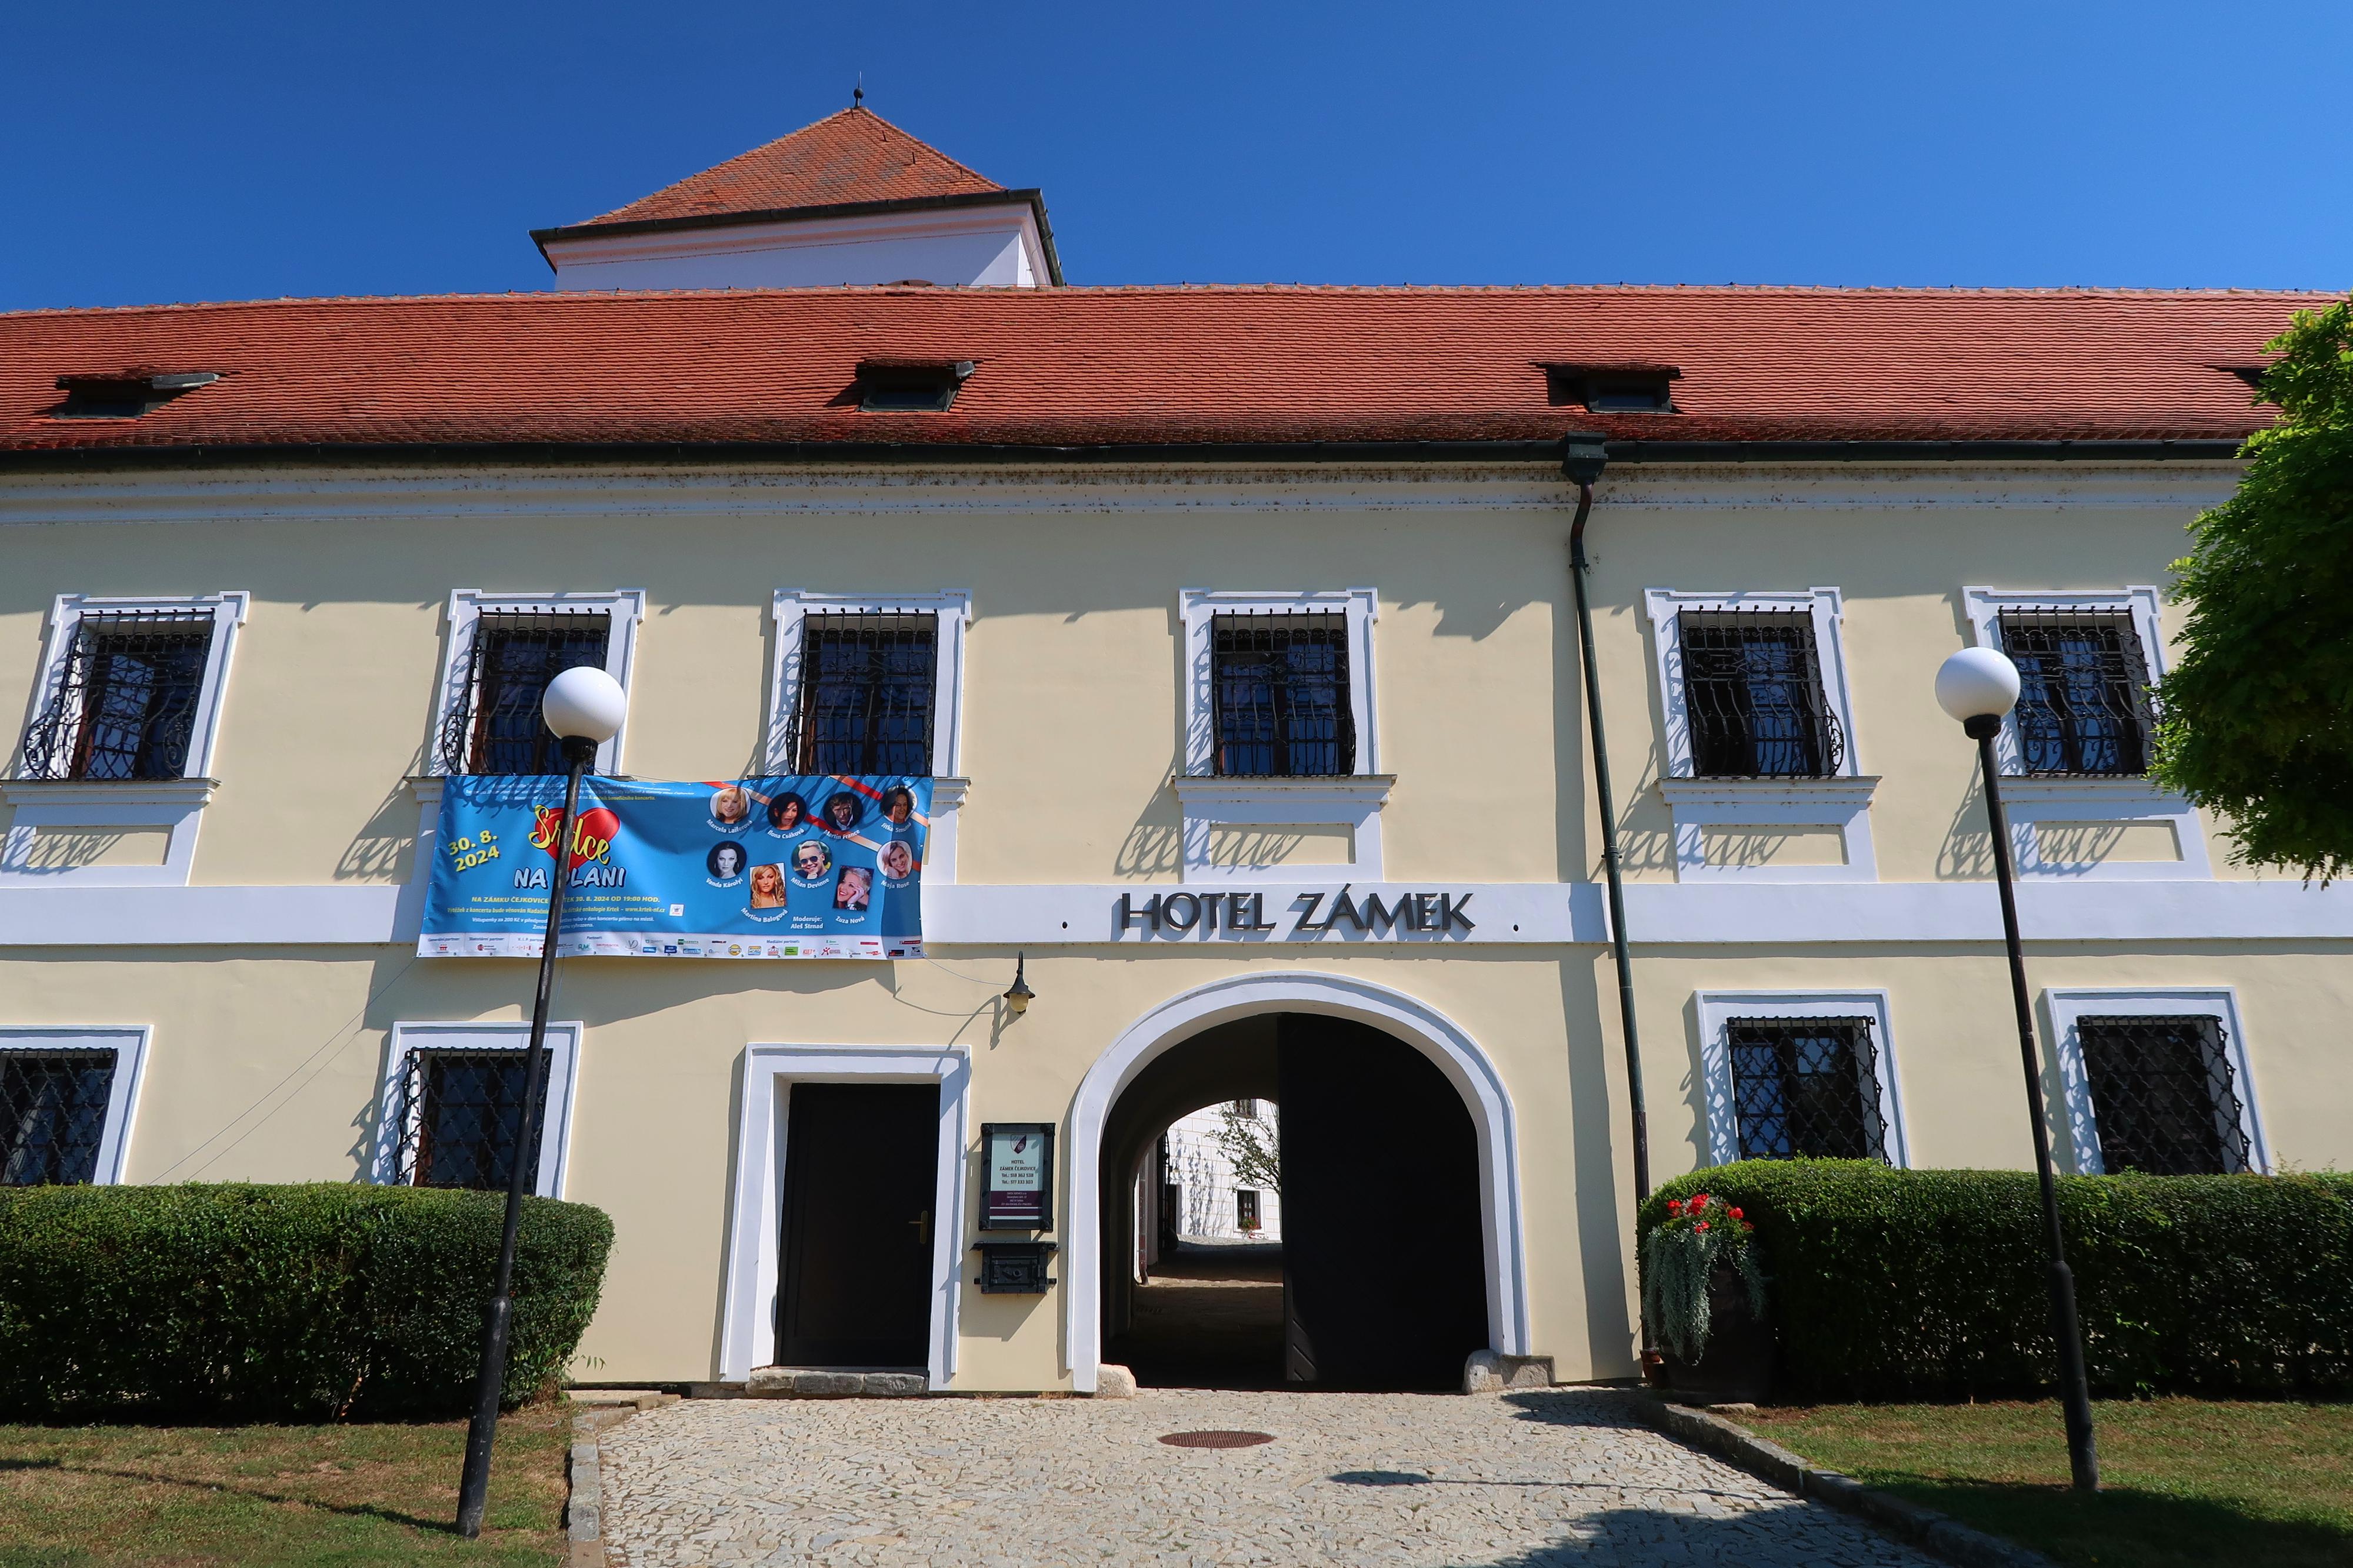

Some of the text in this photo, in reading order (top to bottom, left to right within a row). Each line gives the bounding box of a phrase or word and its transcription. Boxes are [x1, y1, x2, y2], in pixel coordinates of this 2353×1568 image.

[706, 819, 727, 833] Marcela
[881, 822, 894, 832] Jitka
[767, 828, 805, 839] Ilona Csáková
[824, 829, 861, 839] Martin France
[448, 830, 498, 856] 30. 8.
[454, 845, 500, 872] 2024
[514, 866, 626, 889] NA LANI
[705, 878, 722, 888] Vanda
[791, 877, 806, 888] Milan
[881, 880, 895, 889] Maja
[511, 896, 549, 904] ČEJKOVICE
[1121, 883, 1477, 930] HOTEL ZÁMEK
[741, 907, 788, 923] Martina Balogová
[835, 915, 865, 924] Zuza Nová
